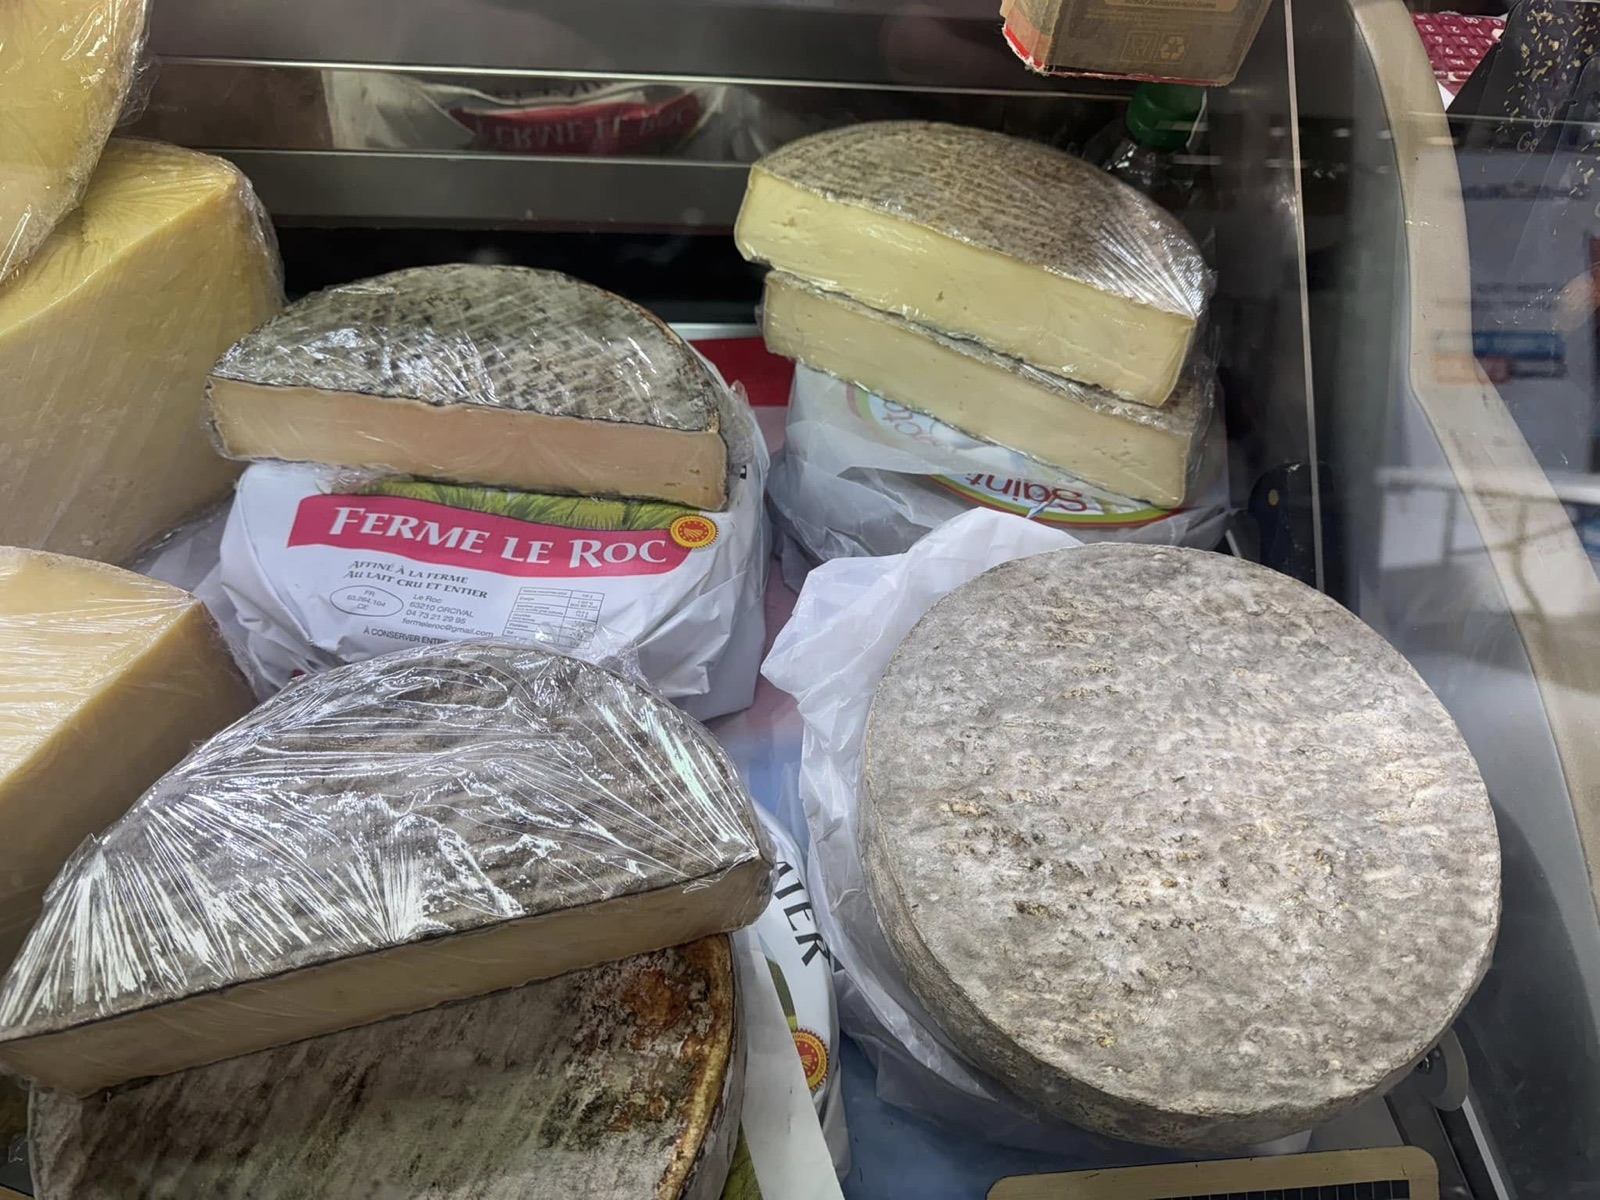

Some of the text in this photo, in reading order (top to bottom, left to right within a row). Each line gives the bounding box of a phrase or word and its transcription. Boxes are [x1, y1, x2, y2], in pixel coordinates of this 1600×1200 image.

[1425, 24, 1435, 32] 3
[1450, 25, 1460, 33] 2
[329, 507, 666, 568] FERME LE ROC
[408, 570, 423, 579] LA
[426, 572, 469, 584] FERME
[366, 572, 395, 583] LAIT
[396, 579, 422, 589] CRU
[426, 582, 442, 591] ET
[444, 585, 489, 599] ENTIER
[425, 595, 443, 604] Roc
[409, 601, 474, 618] 63210 ORCIVAL
[419, 611, 430, 619] 73
[430, 613, 441, 621] 21
[455, 617, 467, 625] 95
[402, 617, 495, 637] fermeleroc@gmail.com
[371, 628, 421, 642] CONSERVER
